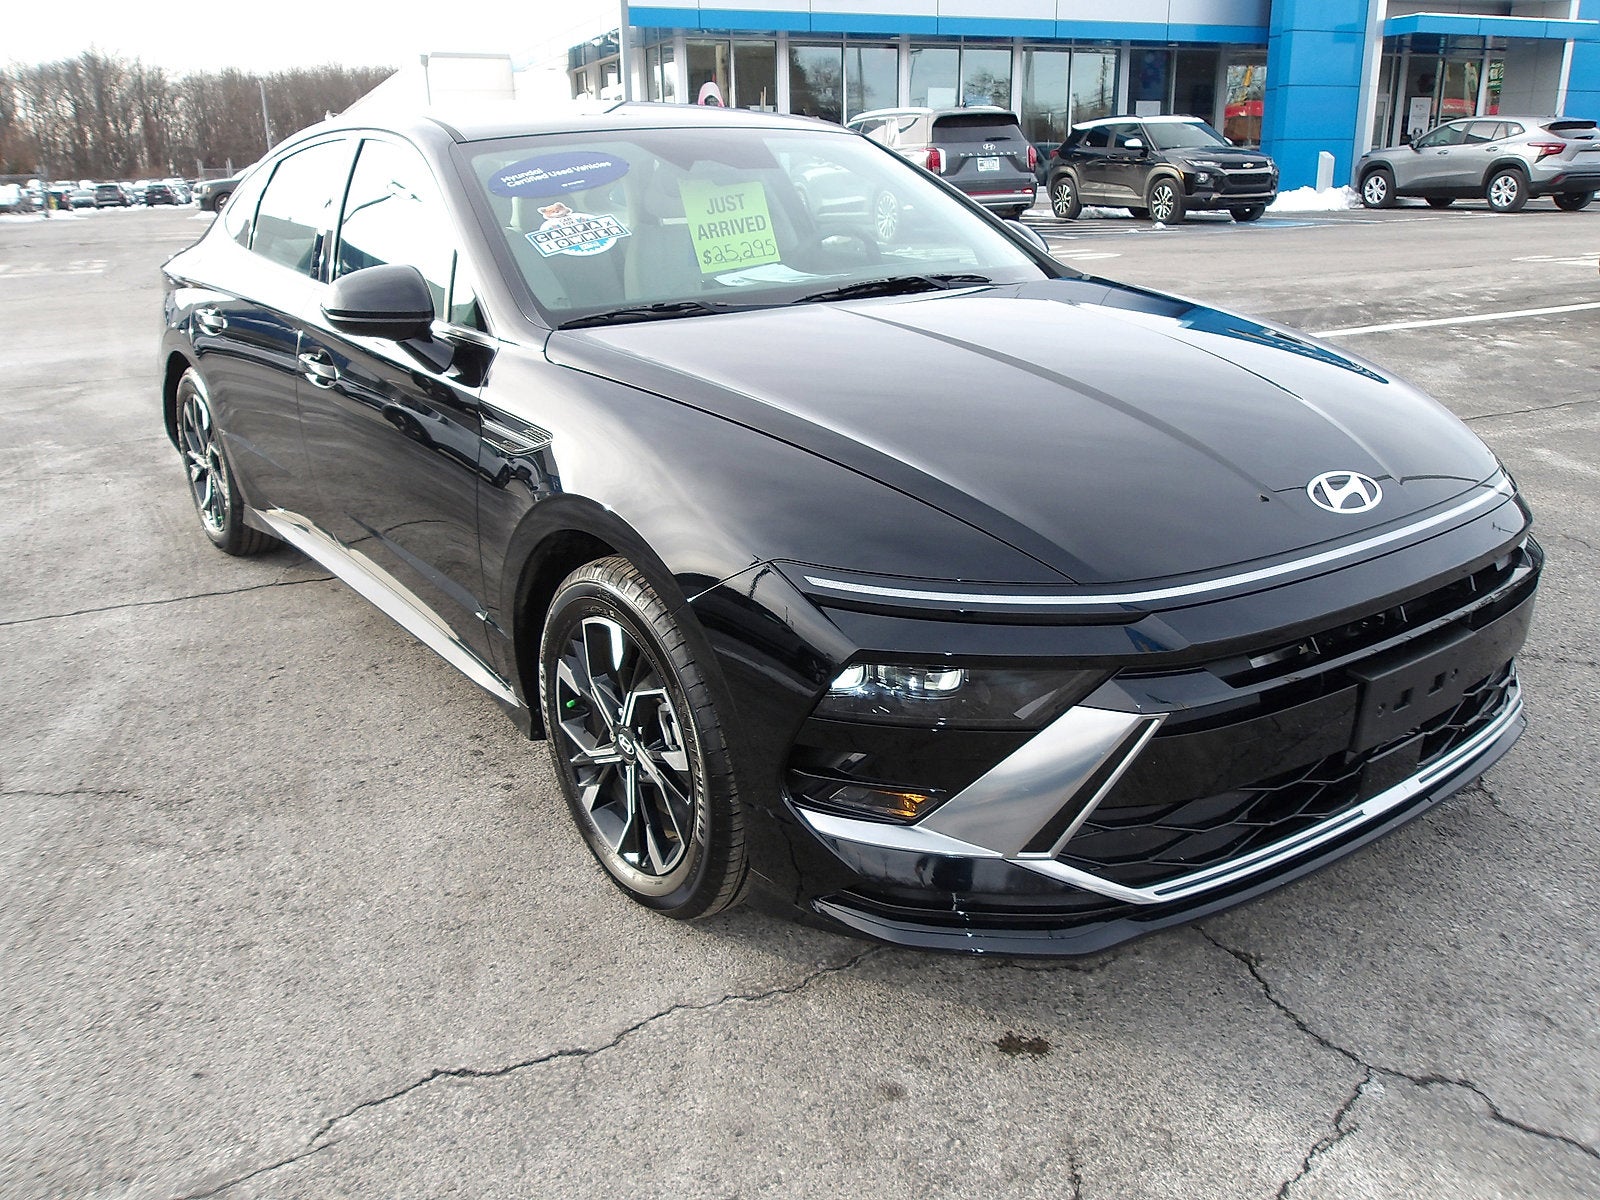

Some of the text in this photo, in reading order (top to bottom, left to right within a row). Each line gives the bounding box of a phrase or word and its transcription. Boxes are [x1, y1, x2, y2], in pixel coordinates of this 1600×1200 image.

[501, 168, 543, 182] Hyundai
[506, 173, 549, 187] Certified
[547, 167, 574, 178] Used
[572, 161, 612, 173] Vehicles
[706, 193, 745, 215] JUST
[533, 220, 613, 244] CARFAX
[557, 226, 623, 249] OWNER
[697, 214, 767, 241] ARRIVED
[702, 239, 776, 265] $25,295
